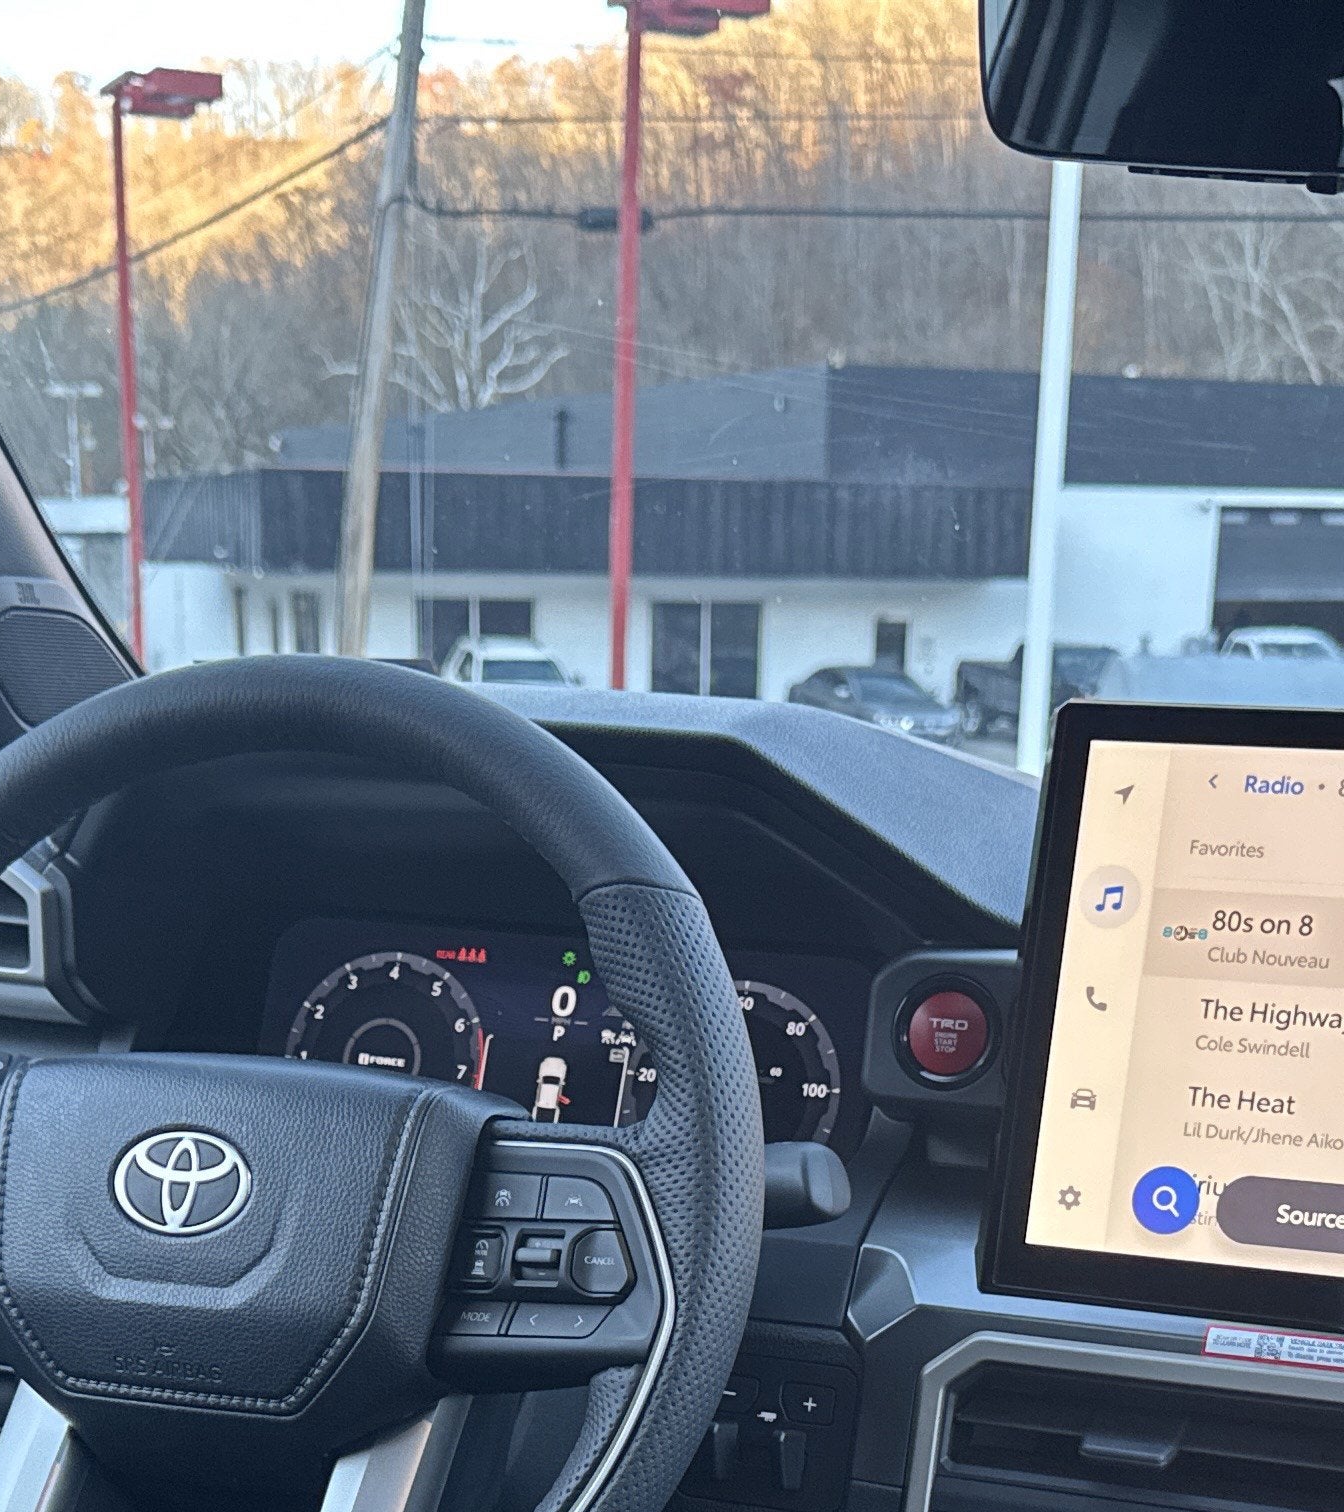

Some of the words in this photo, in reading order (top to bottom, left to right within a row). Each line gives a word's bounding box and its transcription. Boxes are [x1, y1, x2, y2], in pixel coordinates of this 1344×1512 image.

[1244, 774, 1306, 797] Radio
[1189, 839, 1266, 860] Favorites
[1212, 909, 1254, 933] 80s
[1260, 917, 1291, 936] on
[1298, 914, 1314, 937] 8
[1207, 946, 1248, 965] Club
[1252, 950, 1330, 970] Nouveau
[388, 962, 400, 980] 4
[347, 975, 358, 990] 3
[430, 981, 444, 997] 5
[551, 985, 577, 1017] 0
[313, 1004, 325, 1020] 2
[1201, 999, 1243, 1026] The
[454, 1018, 466, 1033] 6
[786, 1021, 806, 1037] 80
[928, 1016, 969, 1032] TRD
[552, 1025, 566, 1042] P
[934, 1038, 958, 1048] START
[935, 1046, 957, 1054] STOP
[1196, 1035, 1234, 1054] Cole
[1238, 1037, 1310, 1060] Swindell
[456, 1064, 467, 1080] 7
[637, 1067, 657, 1083] 20
[802, 1083, 827, 1099] 100
[1188, 1086, 1231, 1112] The
[1237, 1090, 1296, 1116] Heat
[1183, 1122, 1203, 1141] Lil
[1206, 1123, 1304, 1149] Durk/Jhene
[1307, 1131, 1344, 1152] Aiko
[584, 1255, 616, 1266] CANCEL
[460, 1310, 492, 1323] MODE
